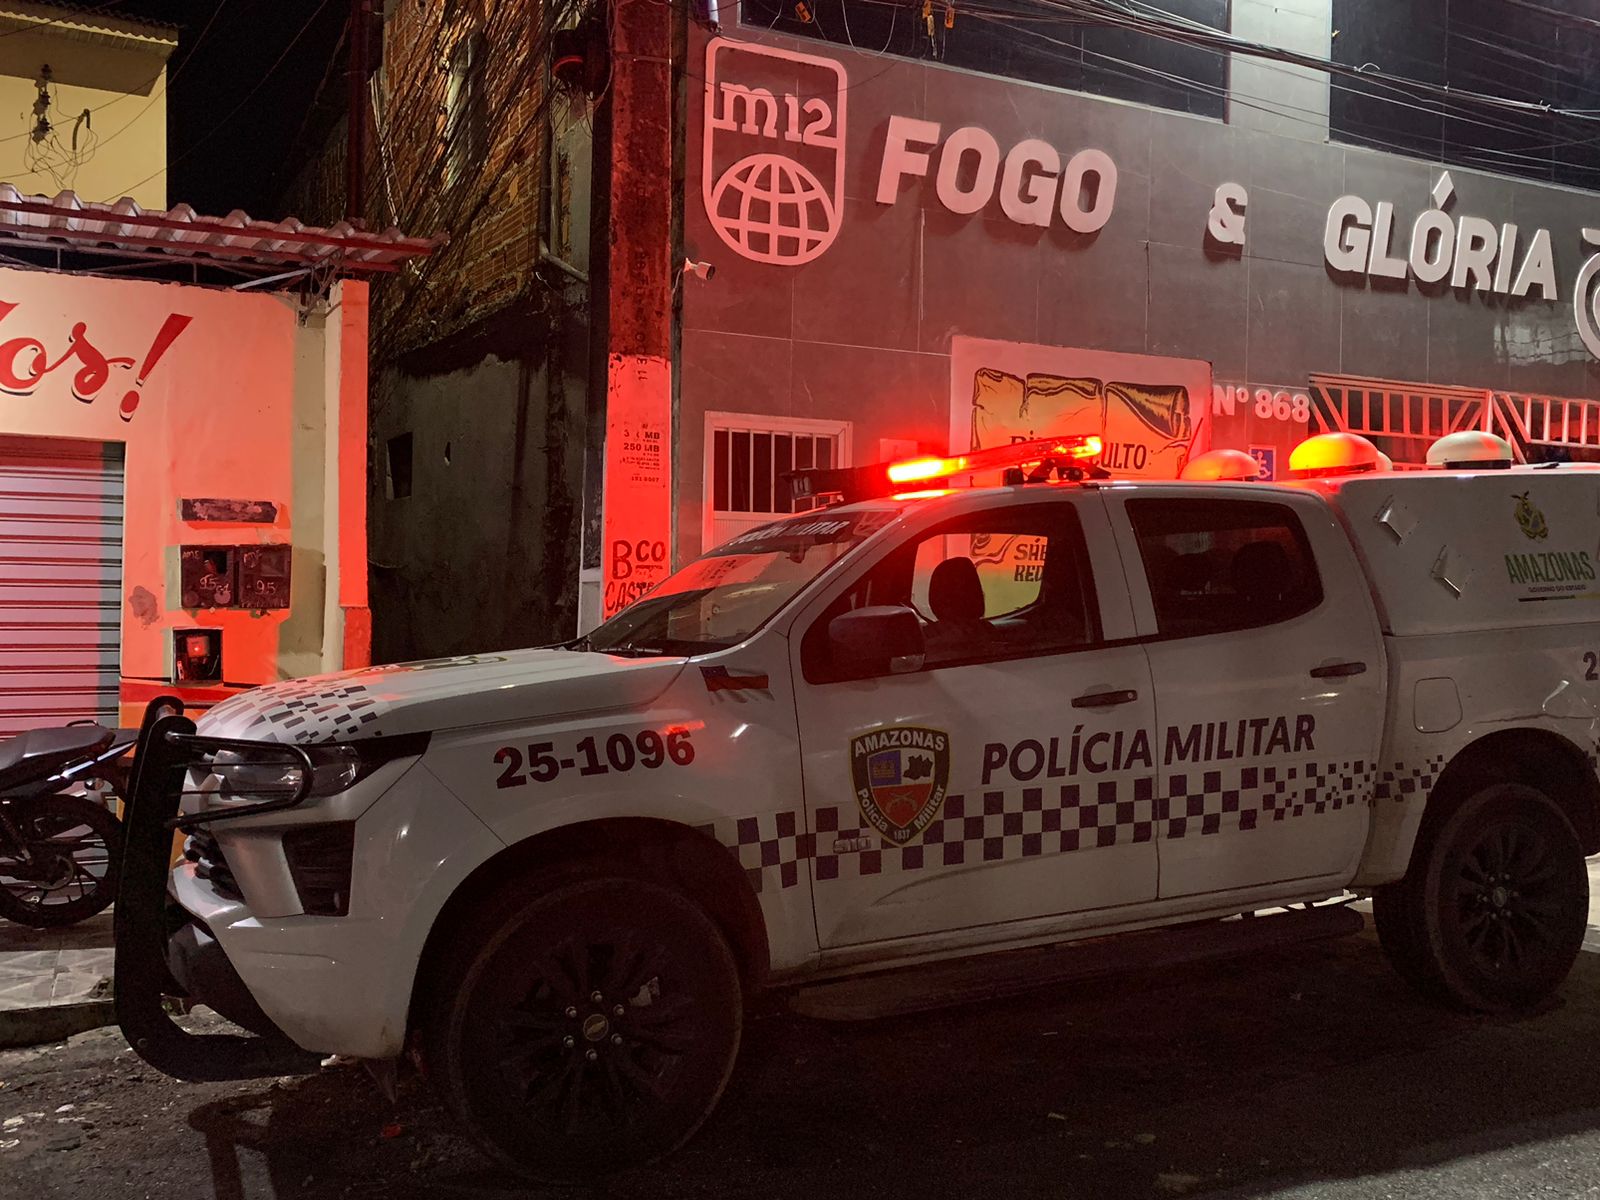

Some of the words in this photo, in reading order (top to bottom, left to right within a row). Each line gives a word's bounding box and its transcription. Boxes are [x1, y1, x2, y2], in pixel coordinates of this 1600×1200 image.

[715, 82, 838, 148] m12
[876, 115, 1117, 233] FOGO
[1208, 182, 1248, 245] &
[1324, 171, 1558, 300] GLÓRIA
[1255, 389, 1310, 423] 868
[623, 442, 642, 451] 250
[1504, 551, 1596, 584] AMAZONAS
[493, 731, 696, 789] 25-1096
[855, 730, 945, 758] AMAZONAS
[981, 725, 1153, 785] POLÍCIA
[1164, 714, 1316, 765] MILITAR
[914, 784, 946, 830] Militar
